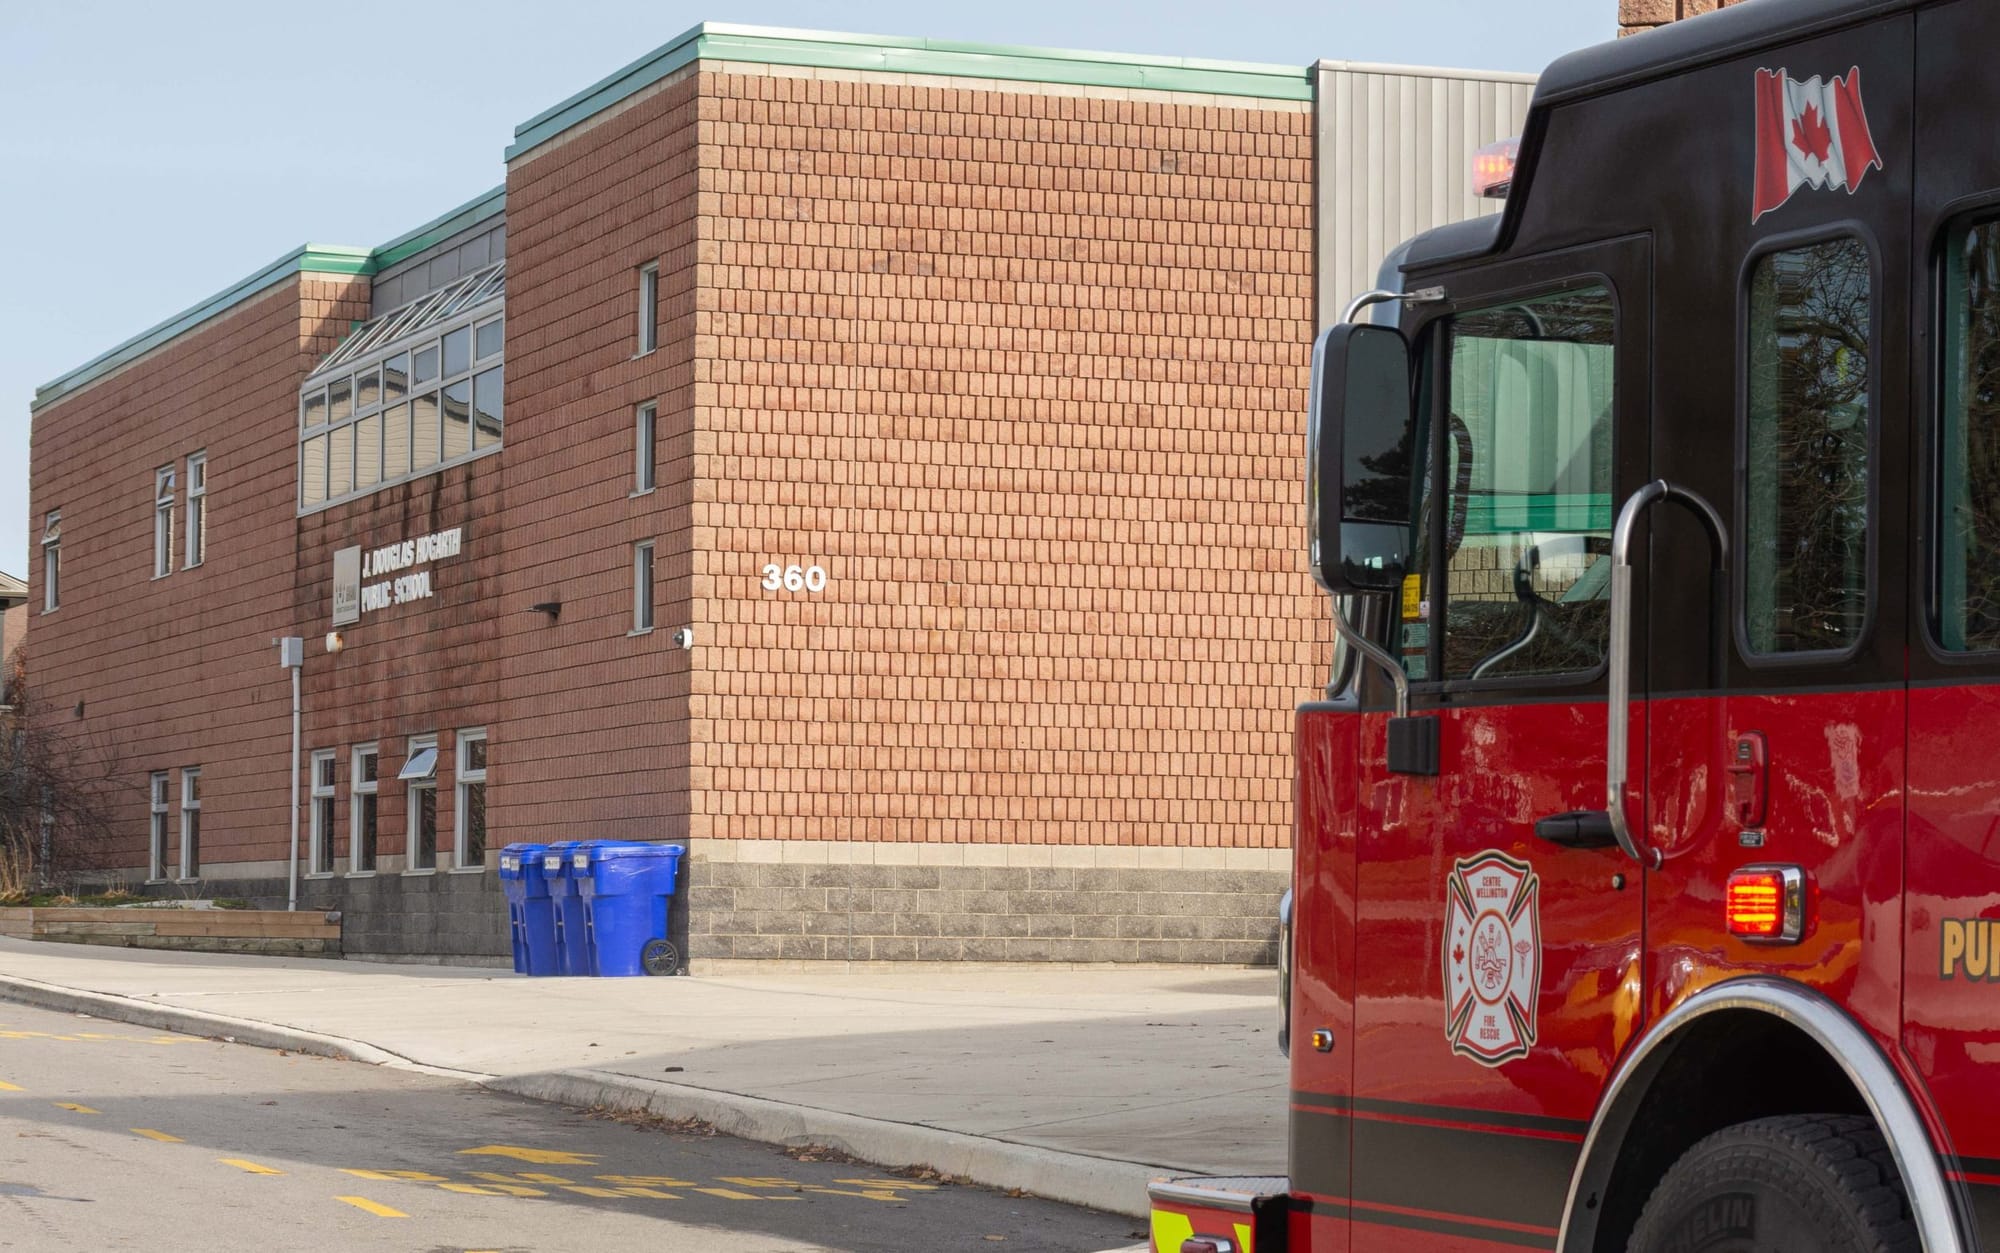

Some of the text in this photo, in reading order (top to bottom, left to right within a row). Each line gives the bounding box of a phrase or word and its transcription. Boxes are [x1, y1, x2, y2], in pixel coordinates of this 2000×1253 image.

[362, 527, 462, 578] J. DOUGLAS HOGARTH
[761, 563, 826, 592] 360
[361, 580, 392, 612] PUBLIC
[394, 571, 433, 605] SCHOOL
[1482, 876, 1501, 886] CENTRE
[1476, 887, 1508, 898] WELLINGTON
[1483, 1015, 1495, 1027] FIRE
[1479, 1027, 1500, 1040] RESCUE
[338, 1168, 940, 1190] BUSES
[436, 1183, 911, 1201] ONLY
